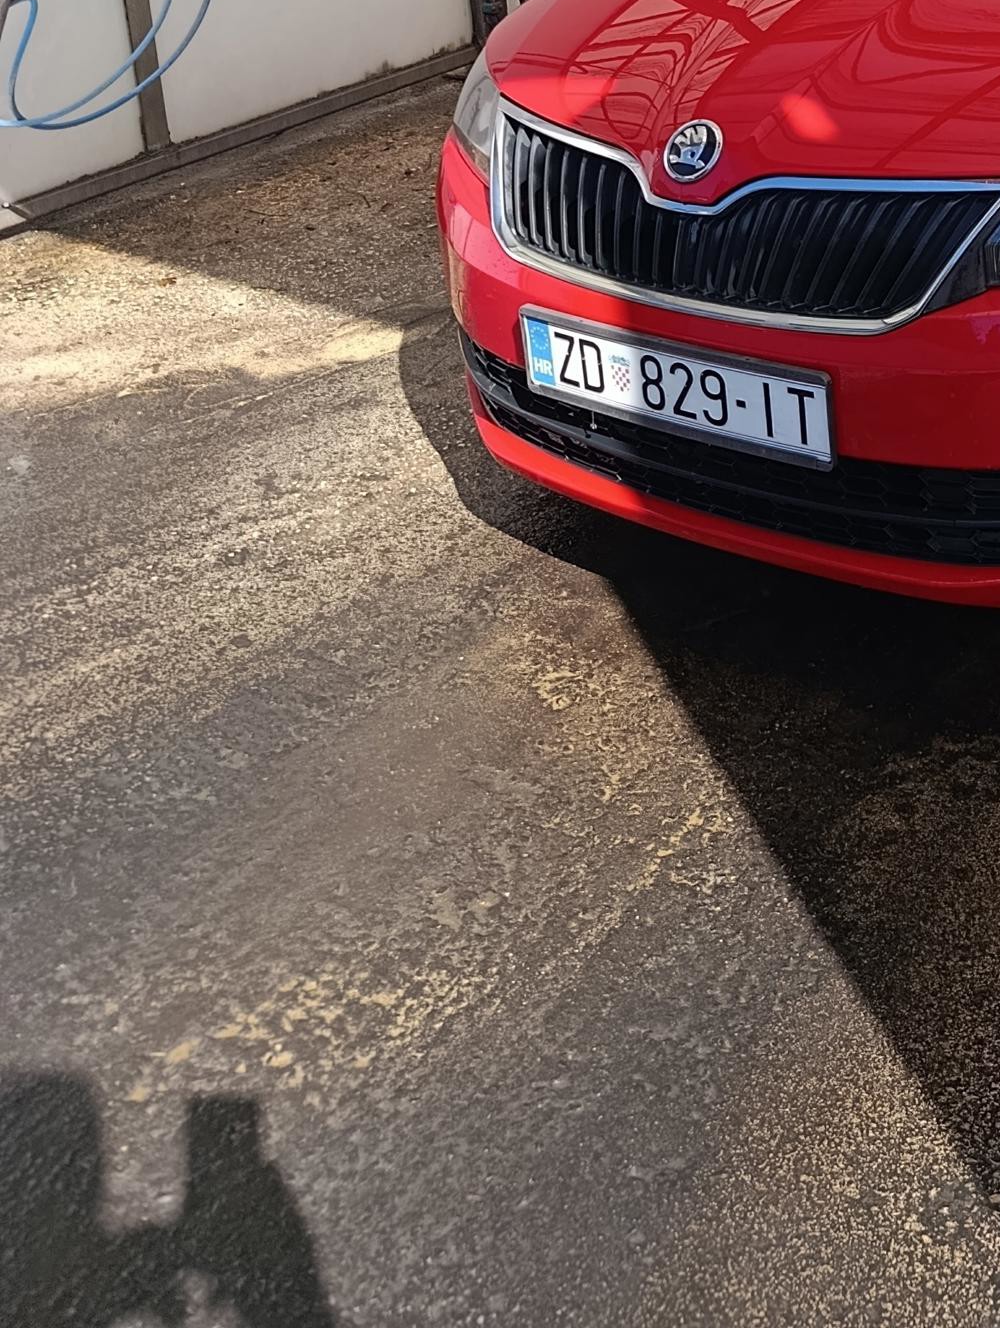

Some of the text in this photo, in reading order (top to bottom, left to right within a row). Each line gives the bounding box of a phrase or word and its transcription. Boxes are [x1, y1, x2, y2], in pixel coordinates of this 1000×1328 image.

[533, 356, 554, 377] HR
[553, 331, 815, 446] ZD 829-IT
